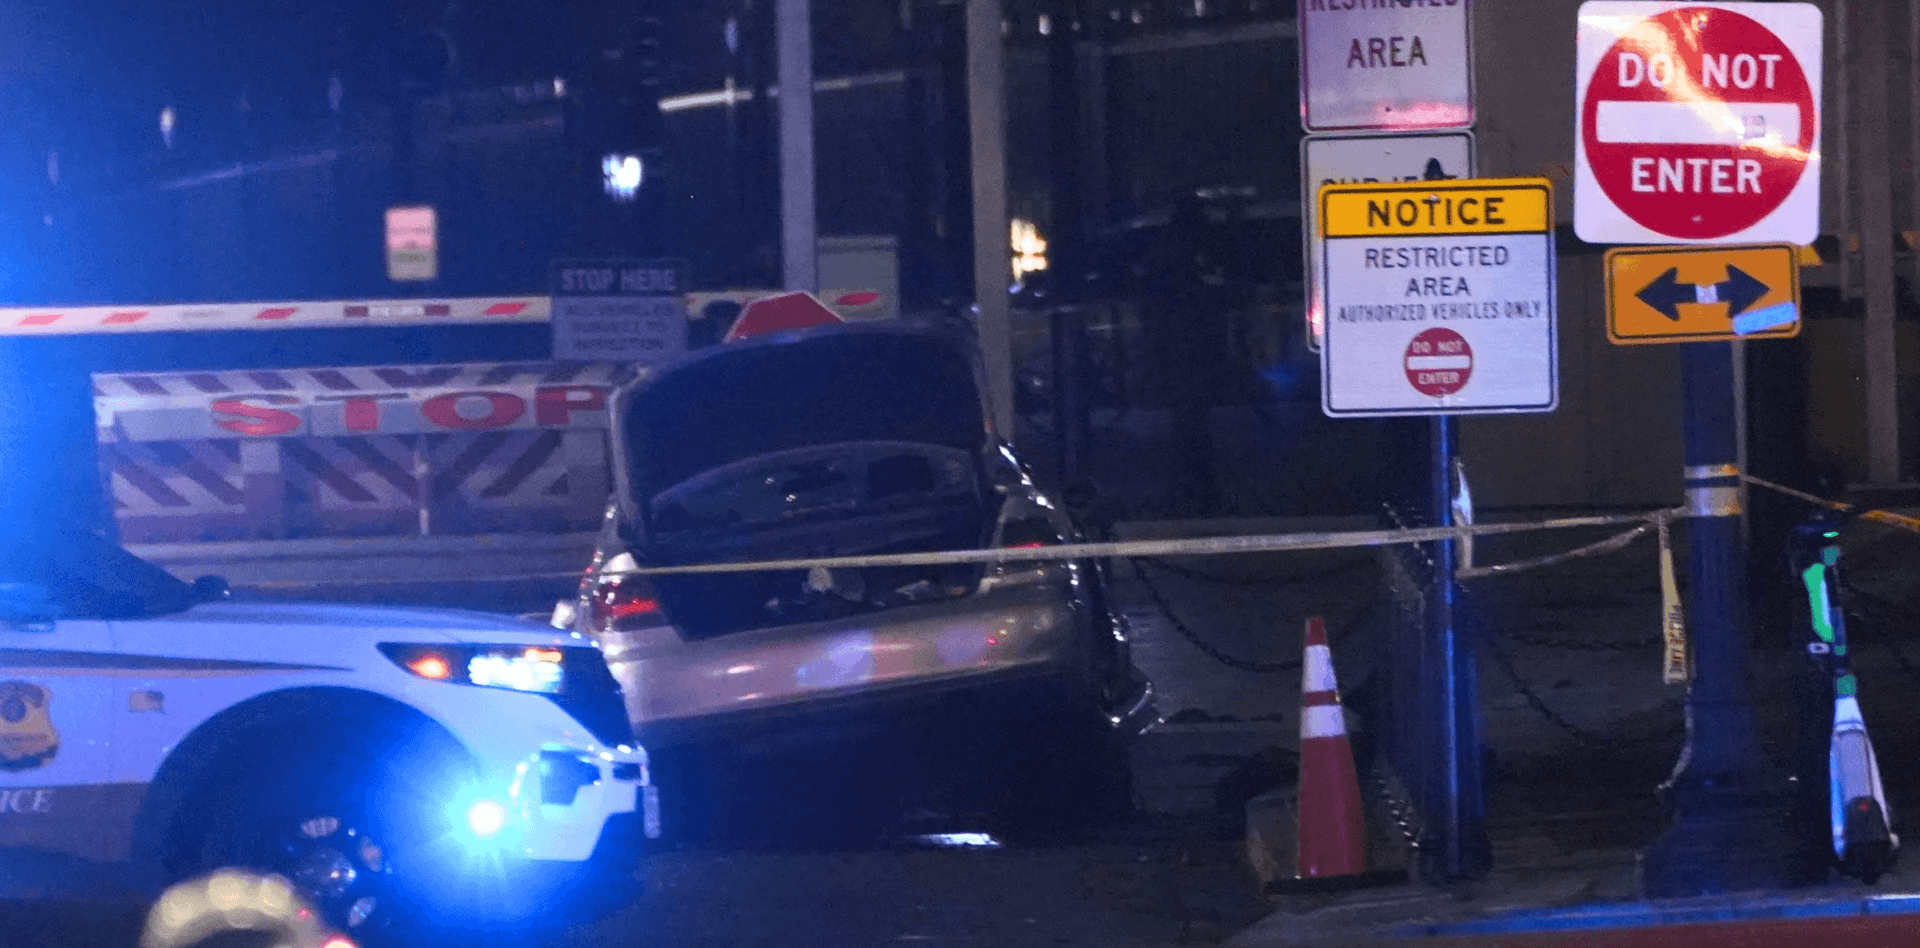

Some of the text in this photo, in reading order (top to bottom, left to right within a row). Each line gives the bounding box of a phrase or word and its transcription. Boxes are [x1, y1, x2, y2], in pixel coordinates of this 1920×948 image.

[1347, 36, 1428, 69] AREA
[1617, 52, 1783, 89] DO NOT
[1631, 157, 1763, 194] ENTER
[1367, 197, 1506, 228] NOTICE
[1364, 245, 1510, 269] RESTRICTED
[561, 268, 677, 291] STOP HERE
[1405, 276, 1472, 297] AREA
[1338, 299, 1541, 323] AUTHORIZED VEHICLES ONLY
[1412, 339, 1463, 353] DO NOT
[1418, 371, 1460, 385] ENTER
[211, 385, 606, 436] STOP
